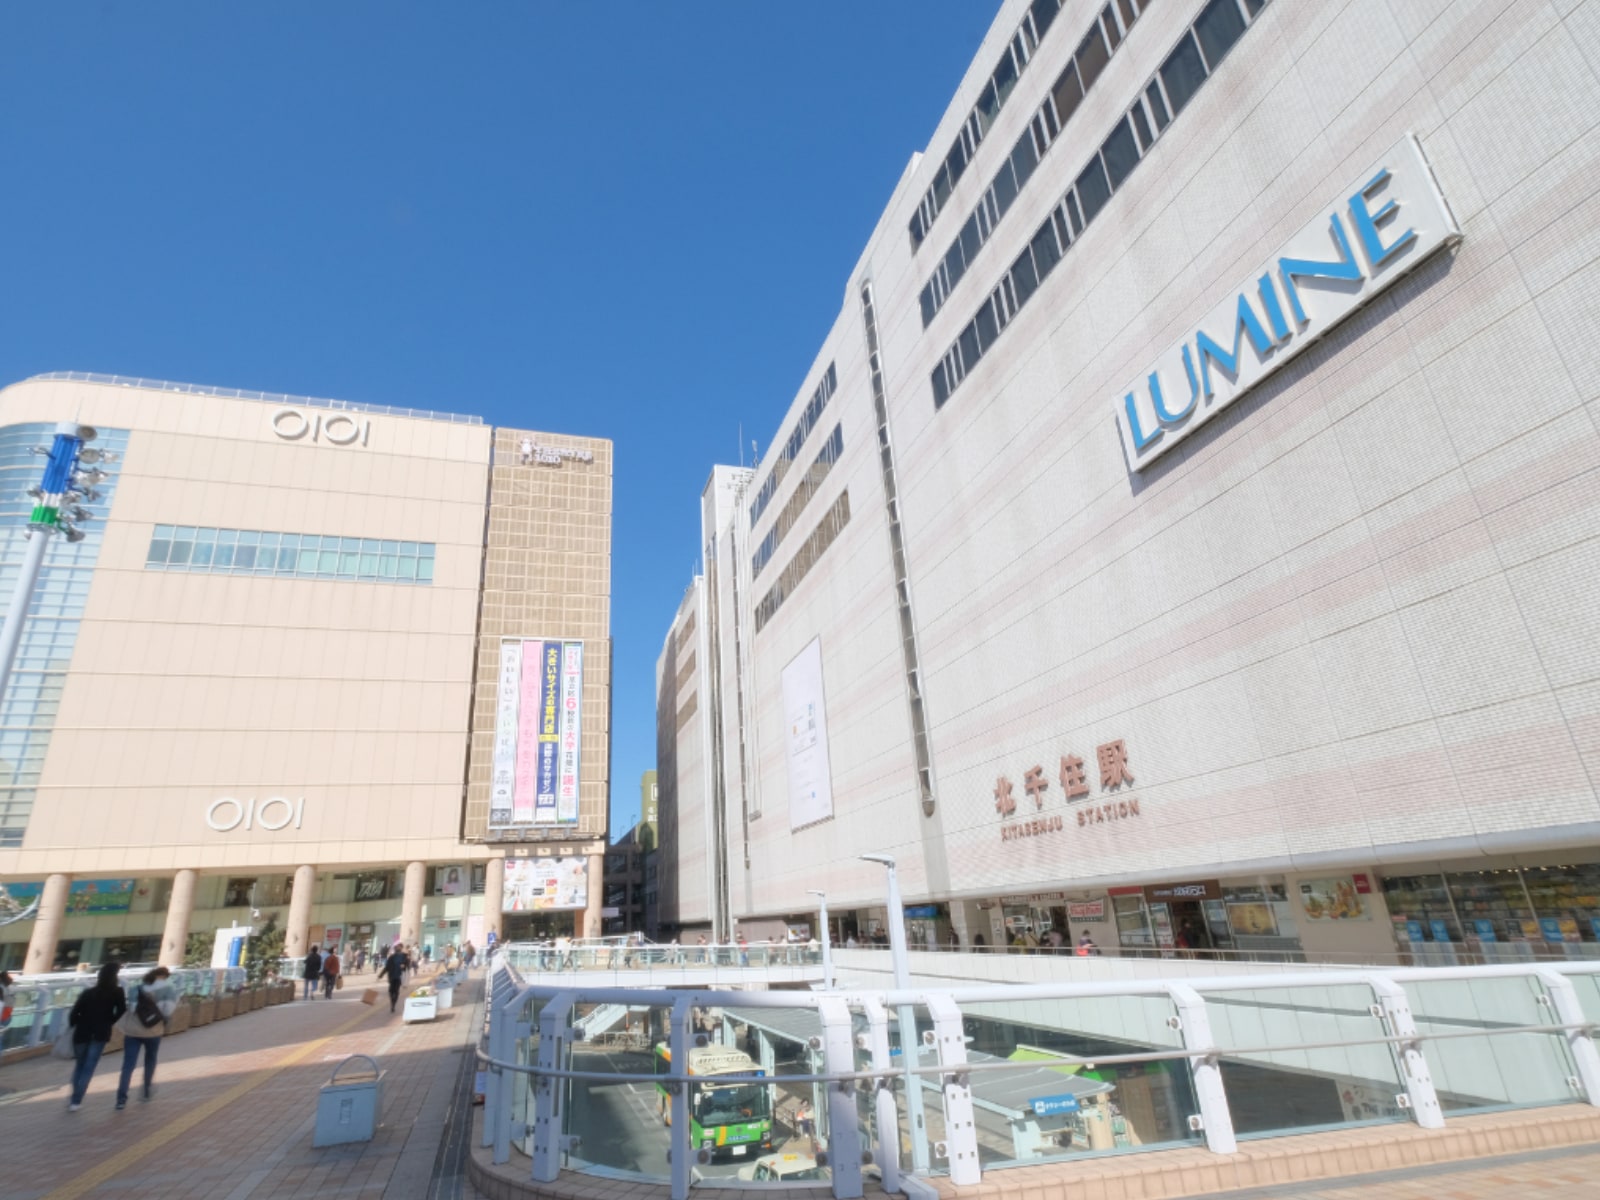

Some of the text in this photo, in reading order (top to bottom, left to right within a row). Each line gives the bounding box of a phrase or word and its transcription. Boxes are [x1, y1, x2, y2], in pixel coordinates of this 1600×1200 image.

[1124, 167, 1418, 450] LUMINE
[993, 739, 1134, 817] 北千住駅
[1001, 799, 1139, 842] KITASENJU STATION
